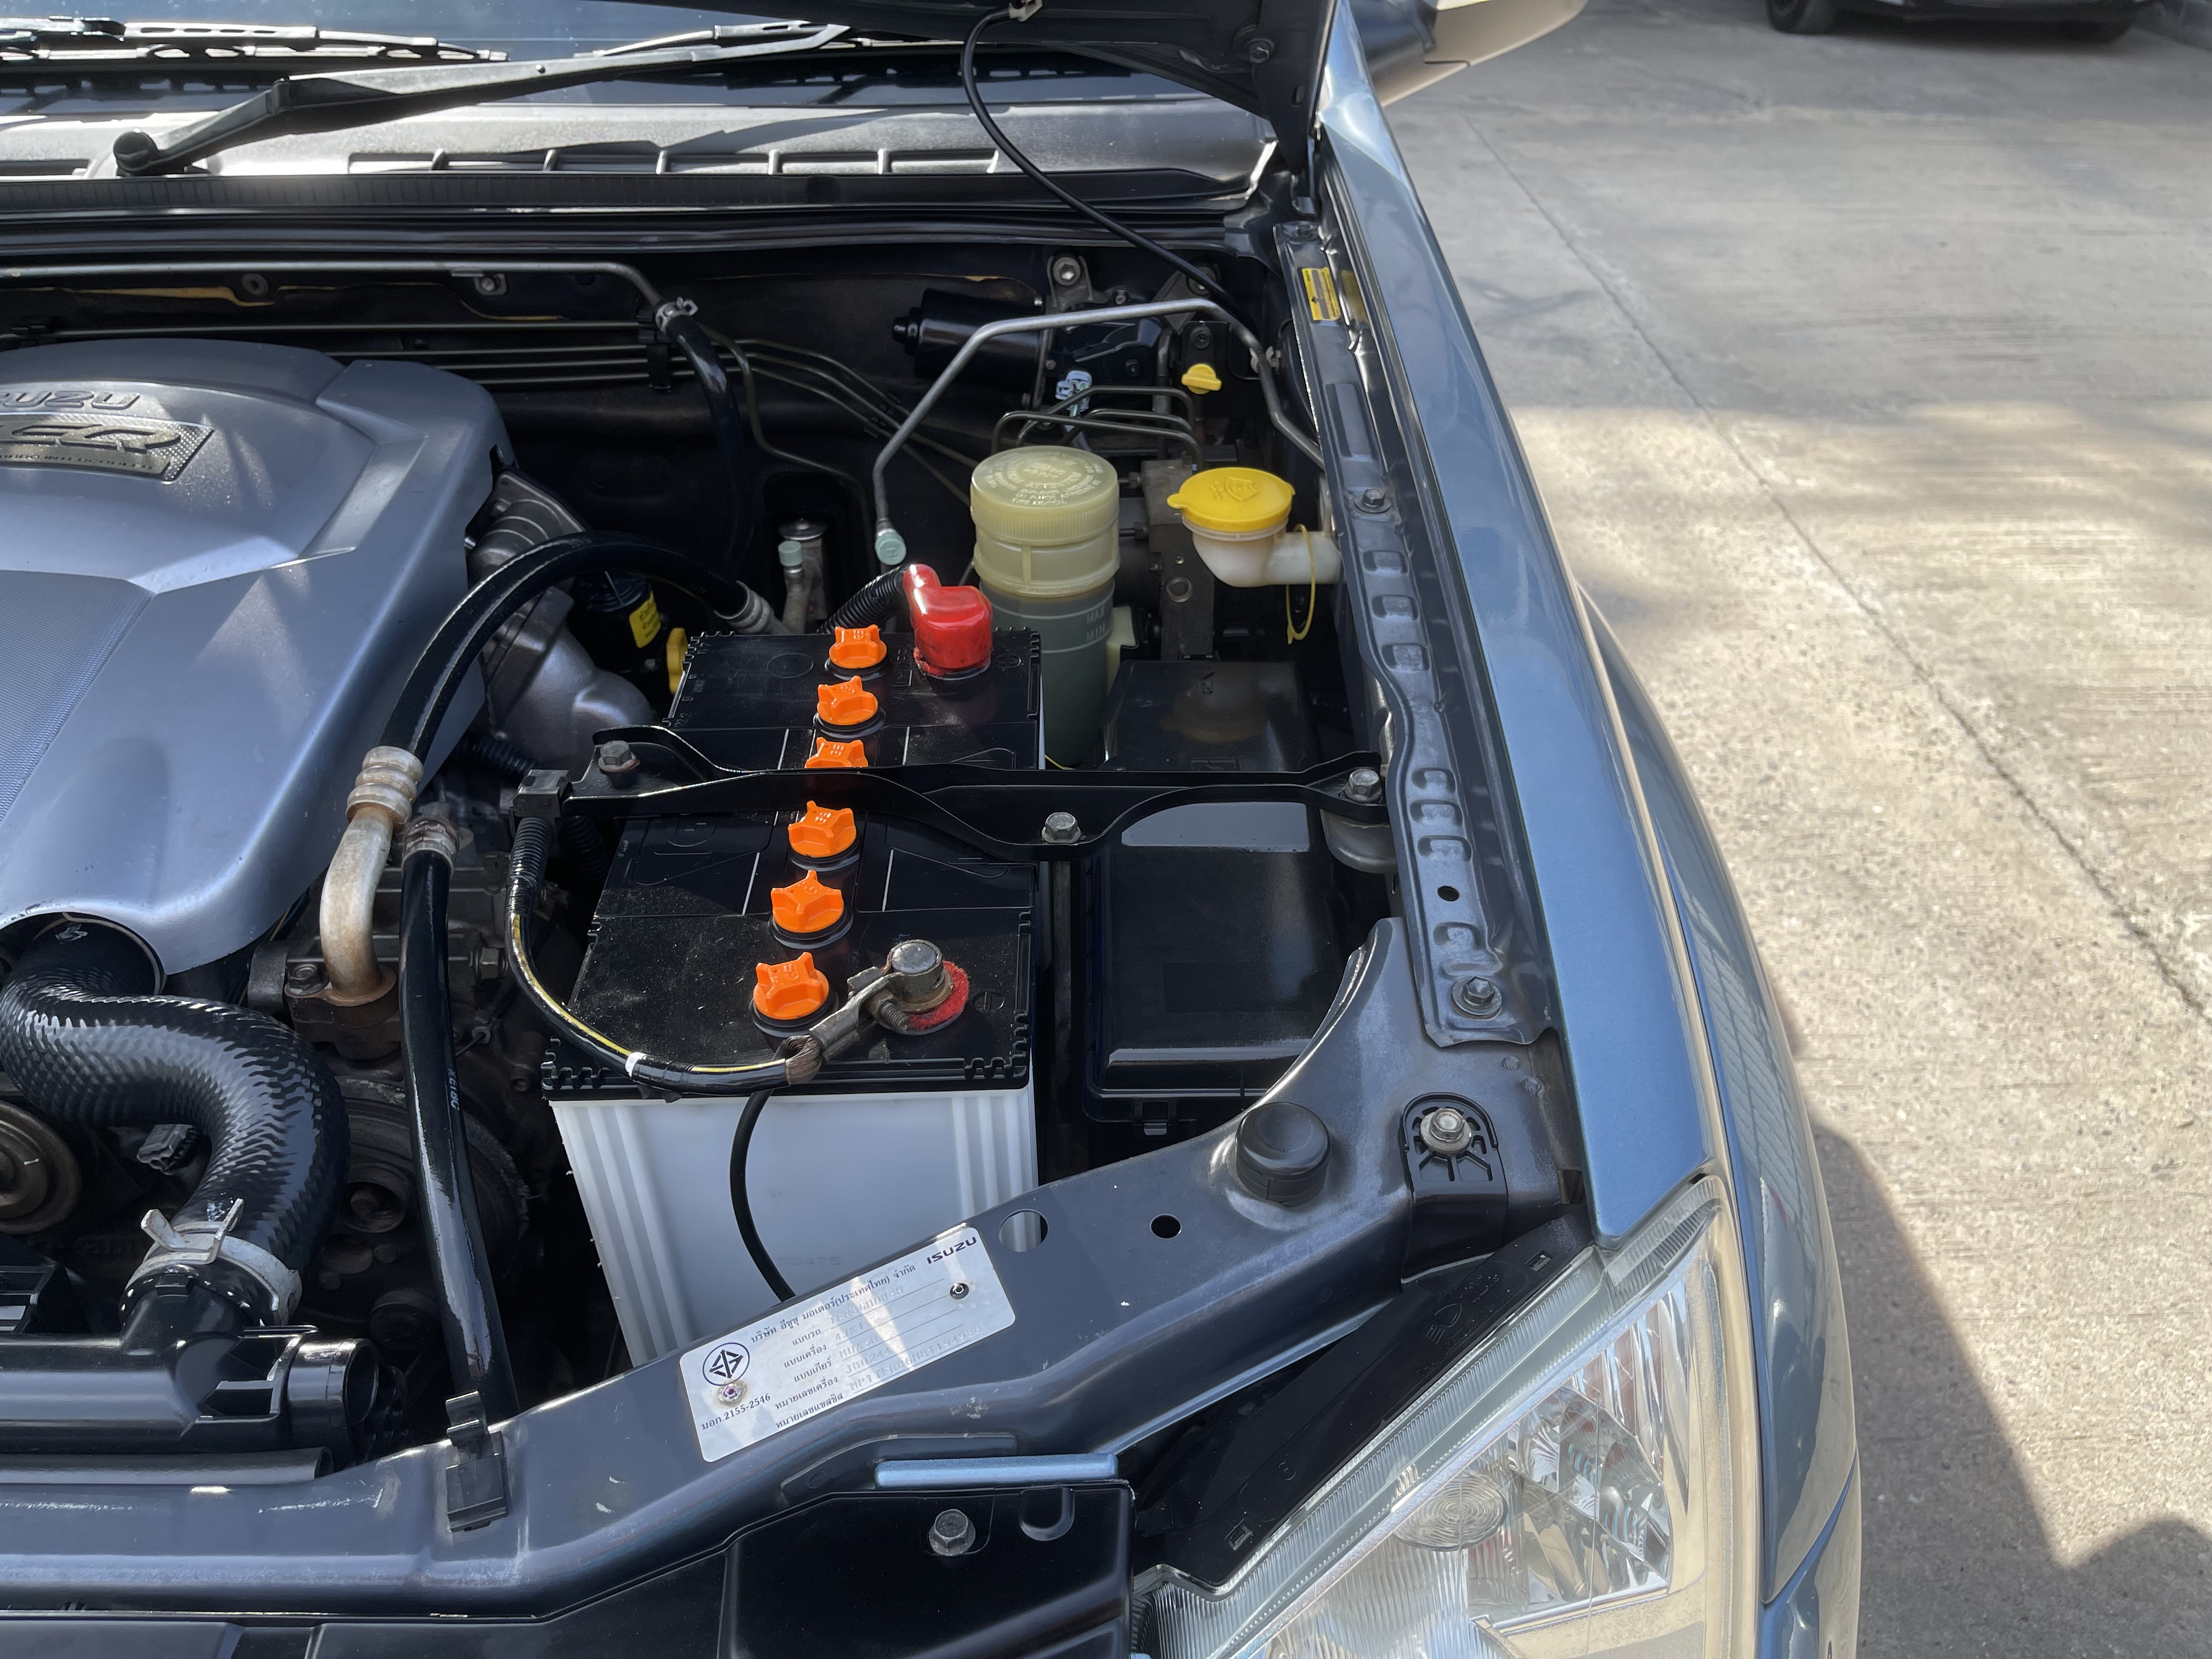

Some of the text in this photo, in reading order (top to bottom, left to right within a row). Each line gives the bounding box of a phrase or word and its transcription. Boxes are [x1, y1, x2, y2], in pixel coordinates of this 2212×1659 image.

[1086, 605, 1106, 624] MAX
[1086, 623, 1106, 642] MIN
[926, 1236, 977, 1265] ISUZU
[751, 1264, 916, 1343] บริษัท อีซูซุ มอเตอร์(ประเทศไทย) จำกัด
[792, 1327, 822, 1346] แบบรถ
[784, 1342, 827, 1368] แบบเครื่อง
[794, 1356, 832, 1383] แบบเกียร์
[775, 1375, 838, 1410] หมายเลขเครื่อง
[701, 1393, 771, 1430] มอก.2155-2546
